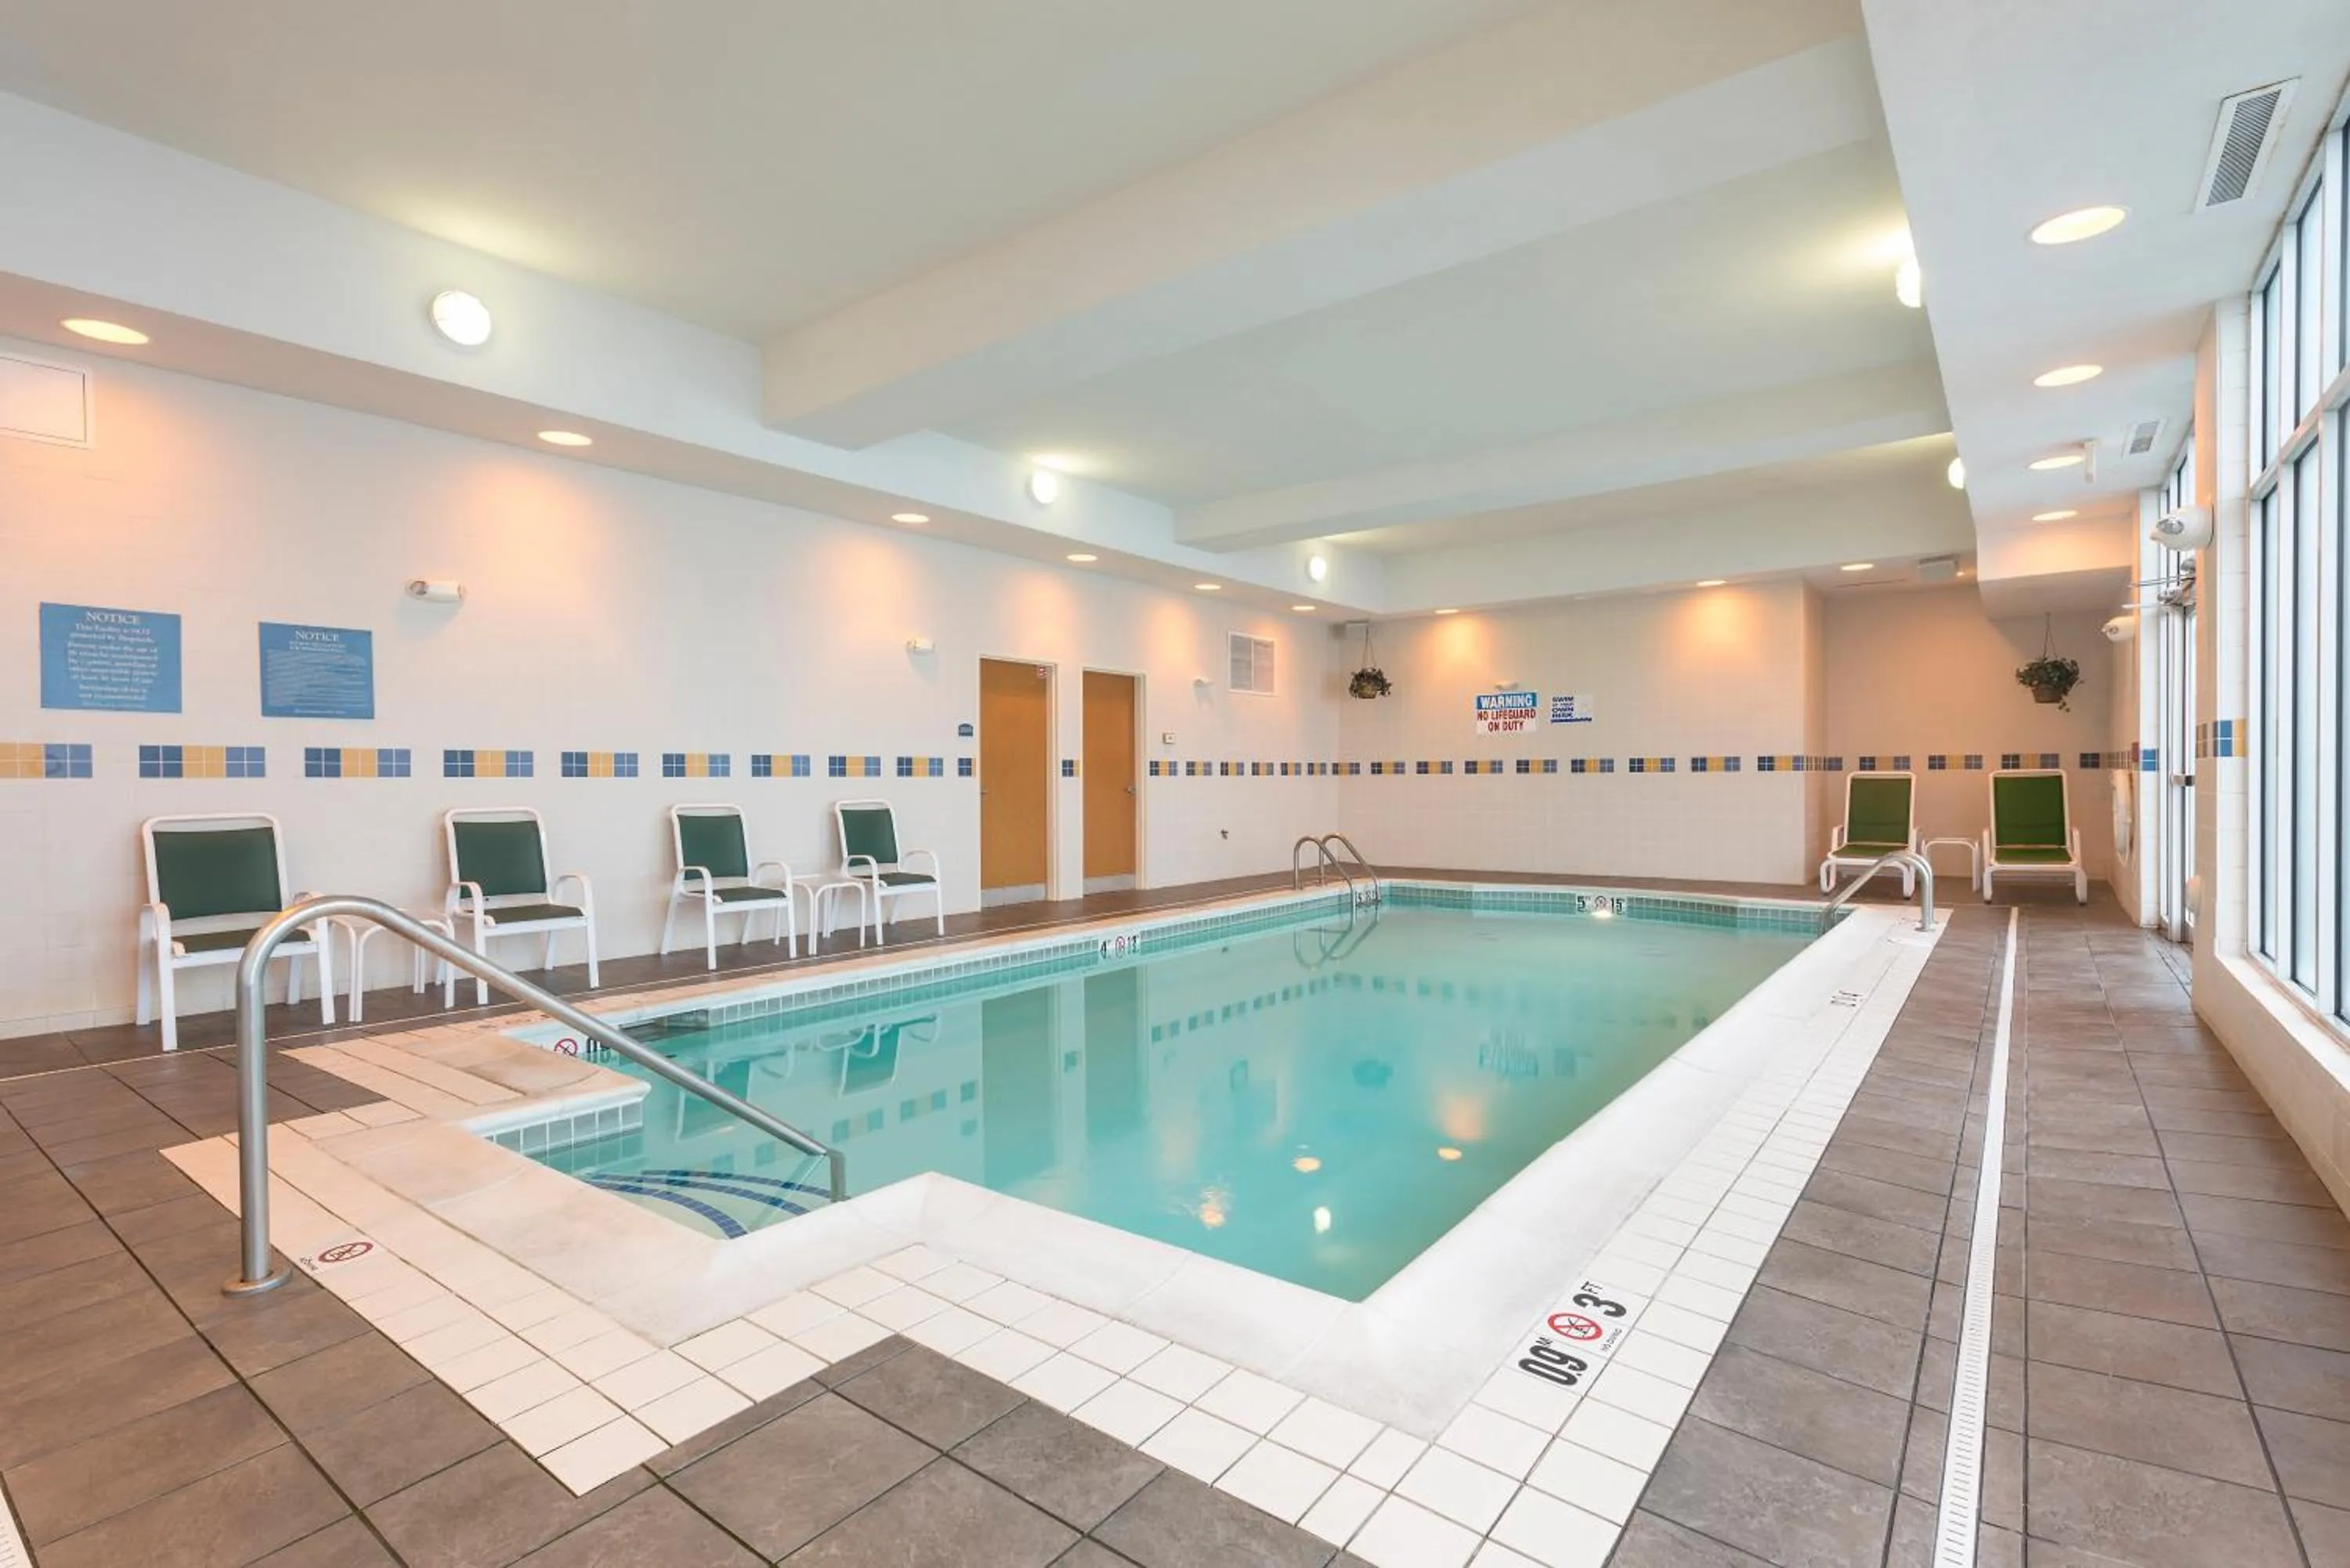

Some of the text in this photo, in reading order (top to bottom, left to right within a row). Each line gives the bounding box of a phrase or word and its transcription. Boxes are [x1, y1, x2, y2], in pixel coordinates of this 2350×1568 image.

[86, 611, 140, 625] NOTICE
[295, 630, 339, 641] NOTICE
[1480, 695, 1532, 708] WARNING
[1477, 709, 1536, 721] NO LIFEGUARD
[1502, 721, 1524, 731] DUTY
[1572, 1281, 1627, 1317] 3 FT
